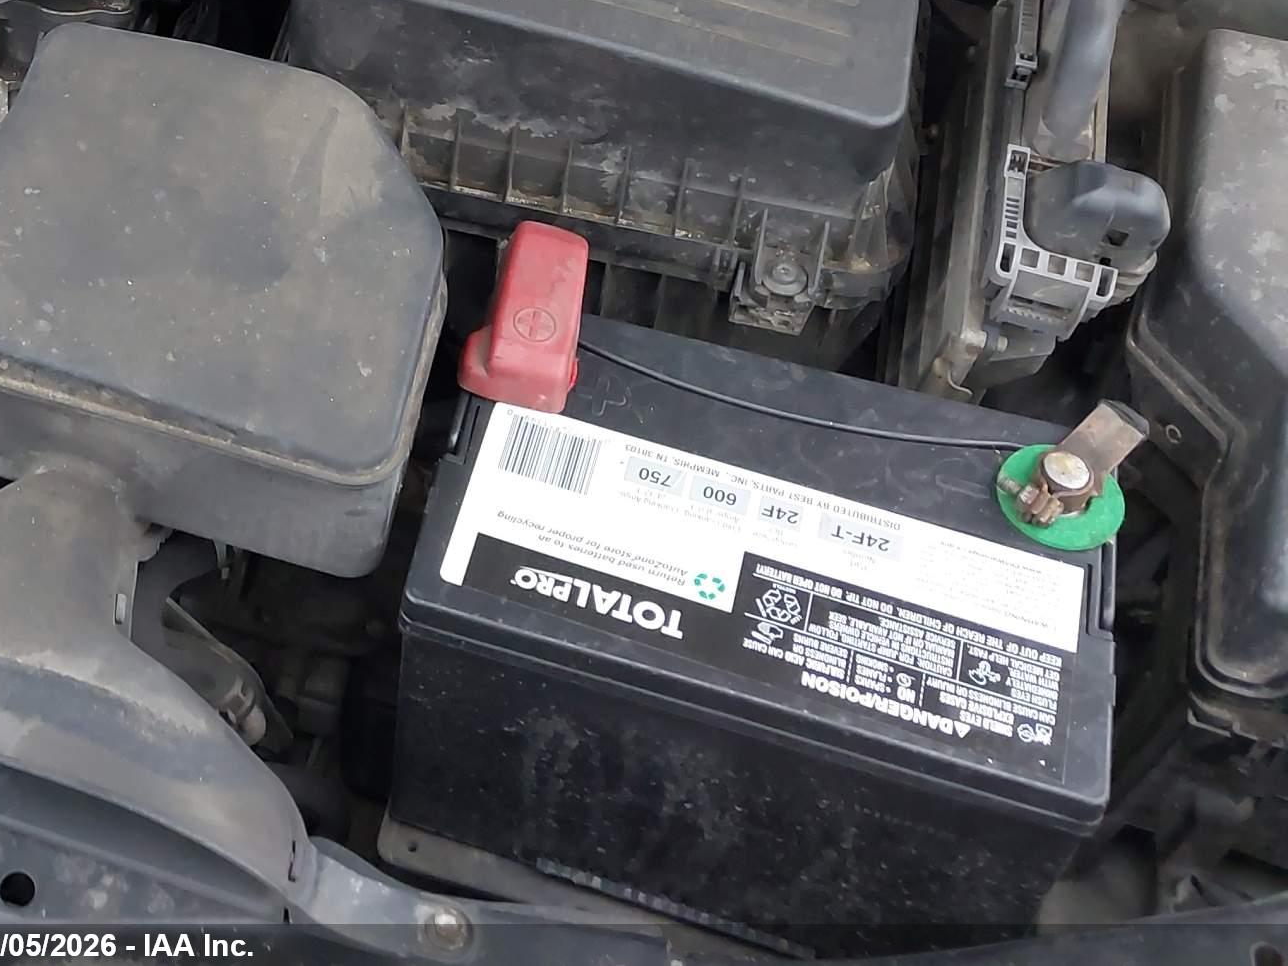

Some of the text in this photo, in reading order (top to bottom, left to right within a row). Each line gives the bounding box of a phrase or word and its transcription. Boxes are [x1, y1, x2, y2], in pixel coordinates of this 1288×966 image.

[655, 452, 668, 462] TN
[670, 456, 720, 478] MEMPHIS,
[637, 466, 673, 488] 750
[701, 484, 737, 506] 600
[749, 479, 785, 497] PARTS,
[787, 491, 813, 505] BEST
[760, 502, 799, 525] 24F
[816, 499, 829, 510] BY
[496, 509, 546, 532] recycling
[832, 504, 901, 531] DISTRIBUTED
[537, 533, 552, 543] an
[546, 525, 584, 544] proper
[584, 538, 601, 550] for
[830, 523, 890, 553] 24F-T
[566, 543, 615, 564] batteries
[603, 544, 632, 559] store
[616, 559, 645, 573] used
[647, 569, 685, 586] Return
[511, 559, 687, 640] TOTALPRO
[755, 562, 1061, 667] KEEP OUT OF THE REACH OF CHILDREN. DO NOT TIP. DO NOT OPEN BATTERY!
[827, 609, 847, 623] SEEK
[808, 622, 839, 640] FOLLOW
[859, 629, 890, 647] VEHICLE
[887, 628, 904, 641] NOT
[924, 630, 956, 648] SERVICE
[791, 632, 848, 659] SEVERE BURNS
[876, 644, 898, 659] JUMP
[889, 638, 900, 650] IN
[911, 636, 924, 648] OR
[923, 640, 955, 657] MANUAL
[742, 636, 845, 679] SULFURIC ACID CAN CAUSE
[791, 642, 846, 669] BLINDNESS OR
[854, 652, 889, 672] SMOKING
[897, 650, 914, 664] FOR
[899, 642, 954, 667] INSTRUCTIONS
[965, 643, 1060, 681] GET MEDICAL HELP FAST.
[854, 663, 887, 682] FLAMES
[853, 673, 885, 693] SPARKS
[1004, 675, 1058, 700] IMMEDIATELY
[1035, 675, 1059, 691] WITH
[799, 670, 954, 735] DANGER/POISON
[895, 684, 916, 704] NO
[925, 675, 1055, 725] CAN CAUSE BLINDNESS OR INJURY
[1009, 686, 1057, 710] FLUSH EYES
[938, 690, 1014, 724] EXPLOSIVE GASES
[958, 709, 1012, 737] SHIELD EYES
